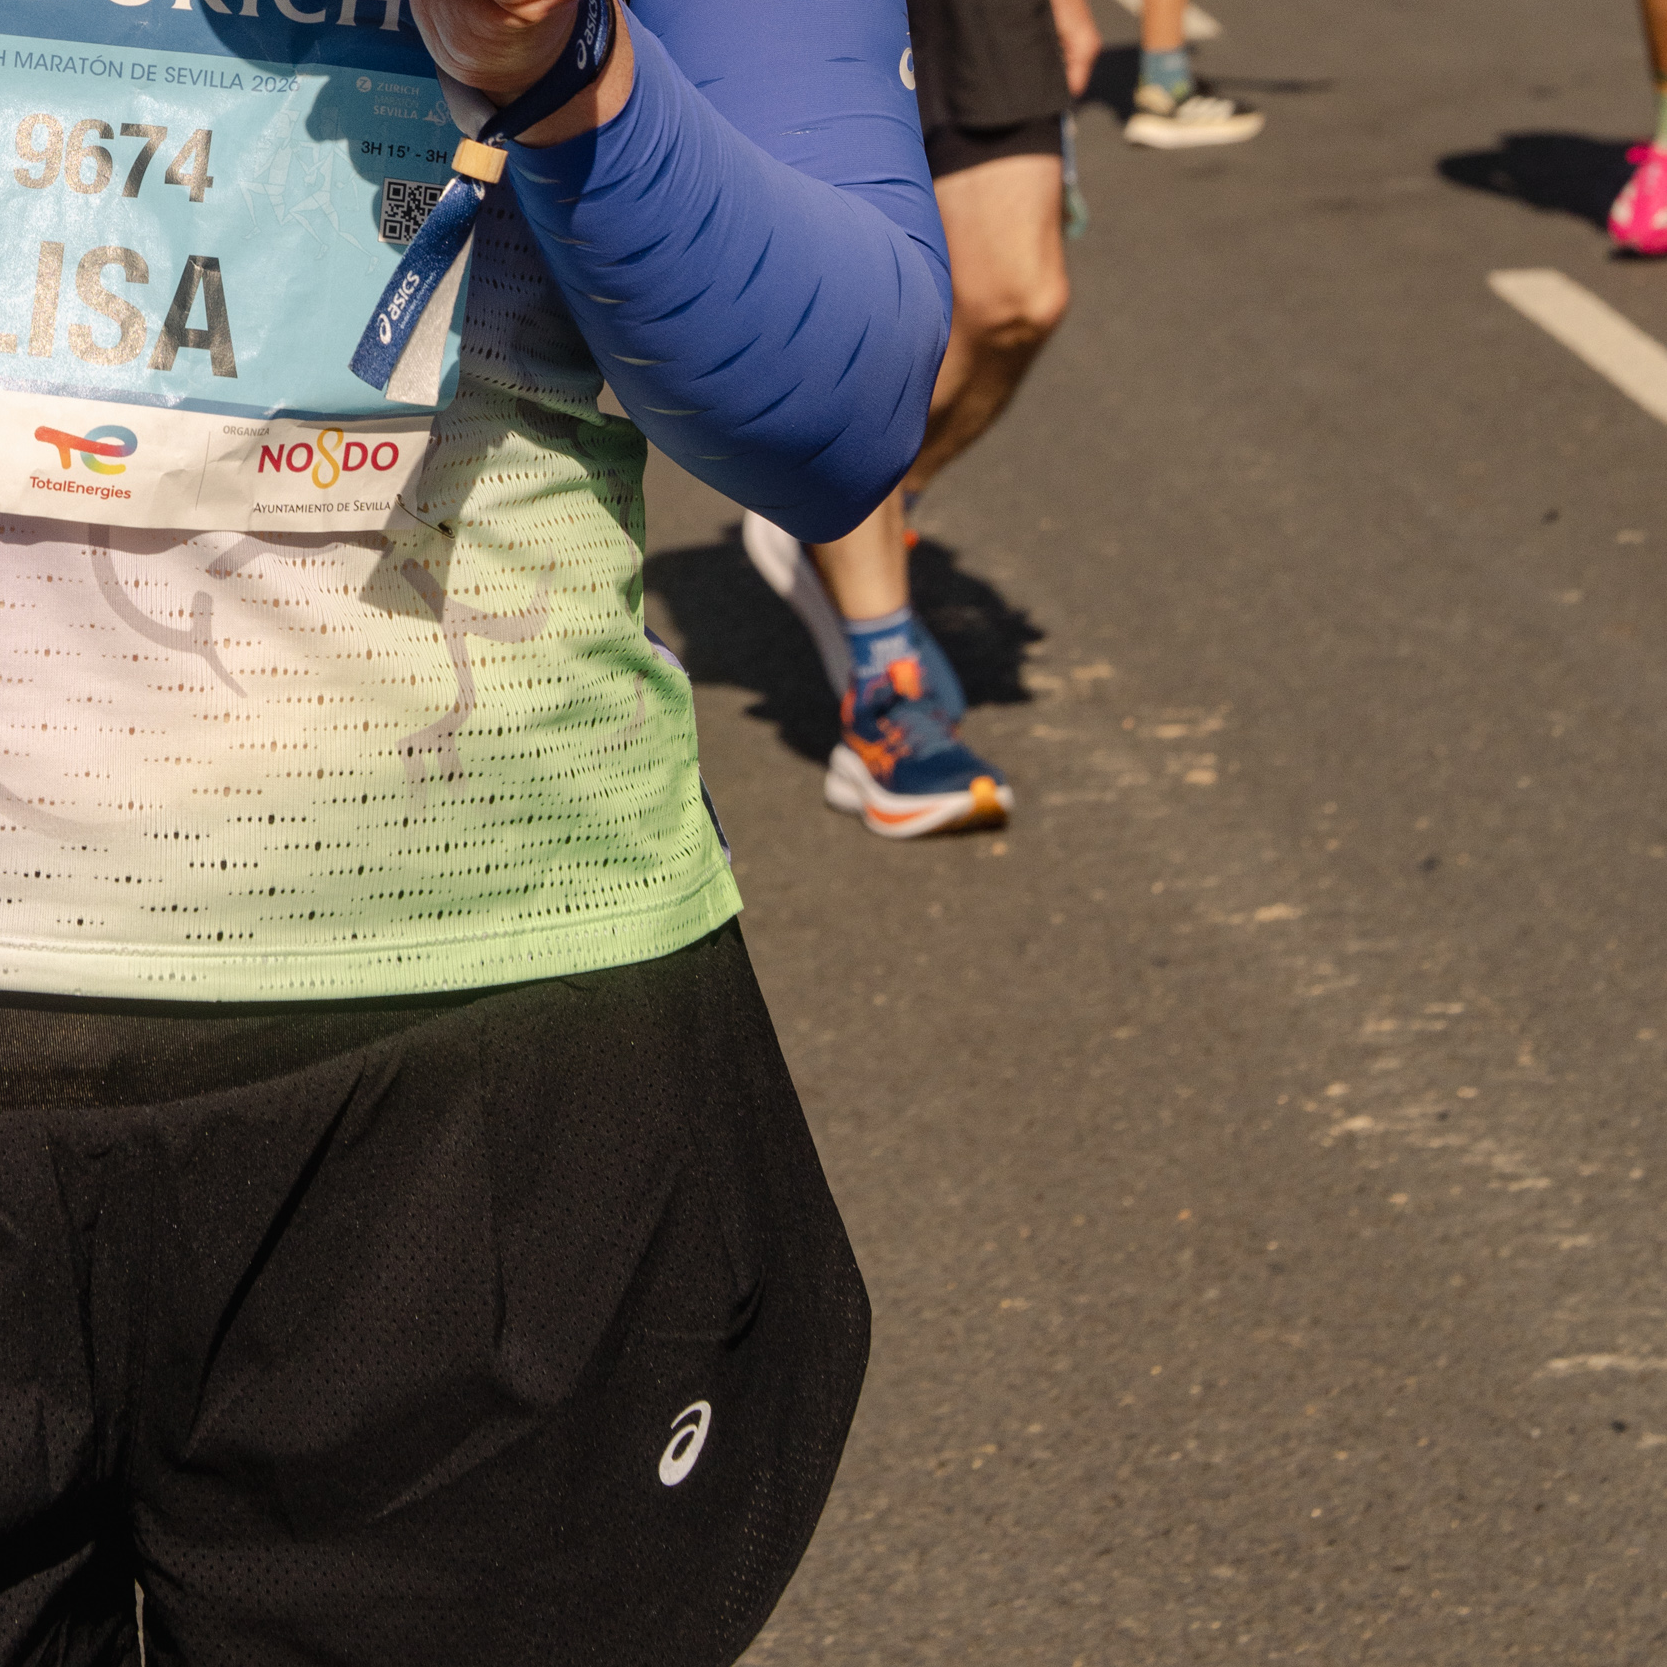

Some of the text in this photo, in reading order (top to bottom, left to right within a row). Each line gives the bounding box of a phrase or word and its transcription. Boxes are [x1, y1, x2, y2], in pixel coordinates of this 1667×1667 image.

[13, 51, 124, 79] MARATÓN
[130, 62, 157, 82] DE
[164, 65, 245, 92] SEVILLA
[251, 74, 301, 94] 2026
[376, 82, 420, 97] ZURICH
[373, 105, 419, 120] SEVILLA
[13, 112, 215, 203] 9674
[361, 140, 382, 156] 3H
[387, 144, 411, 158] 15'
[425, 149, 448, 165] 3H
[388, 270, 420, 321] asics
[223, 424, 271, 436] ORGANIZA
[29, 476, 132, 500] TotalEnergies
[253, 502, 334, 514] AYUNTAMIENTO
[337, 503, 351, 512] DE
